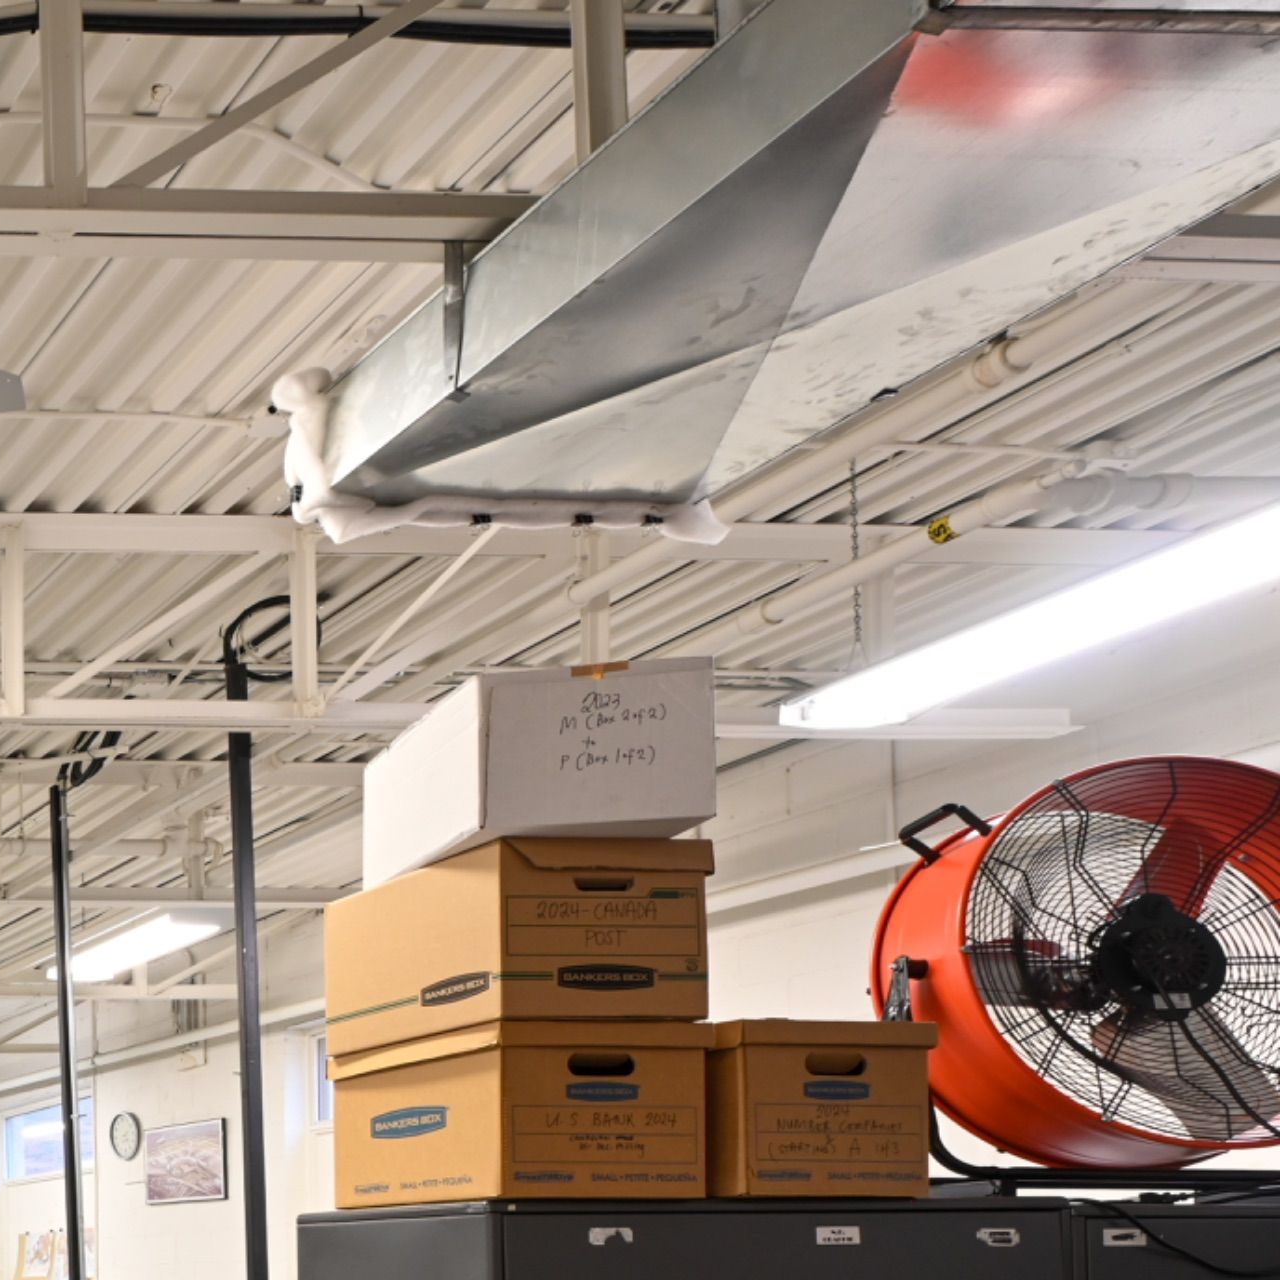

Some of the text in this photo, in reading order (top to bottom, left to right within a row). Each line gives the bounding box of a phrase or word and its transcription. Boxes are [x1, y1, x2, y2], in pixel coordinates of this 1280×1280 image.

[424, 978, 486, 1000] BANKERS BOX
[375, 1112, 443, 1132] BANKERS BOX
